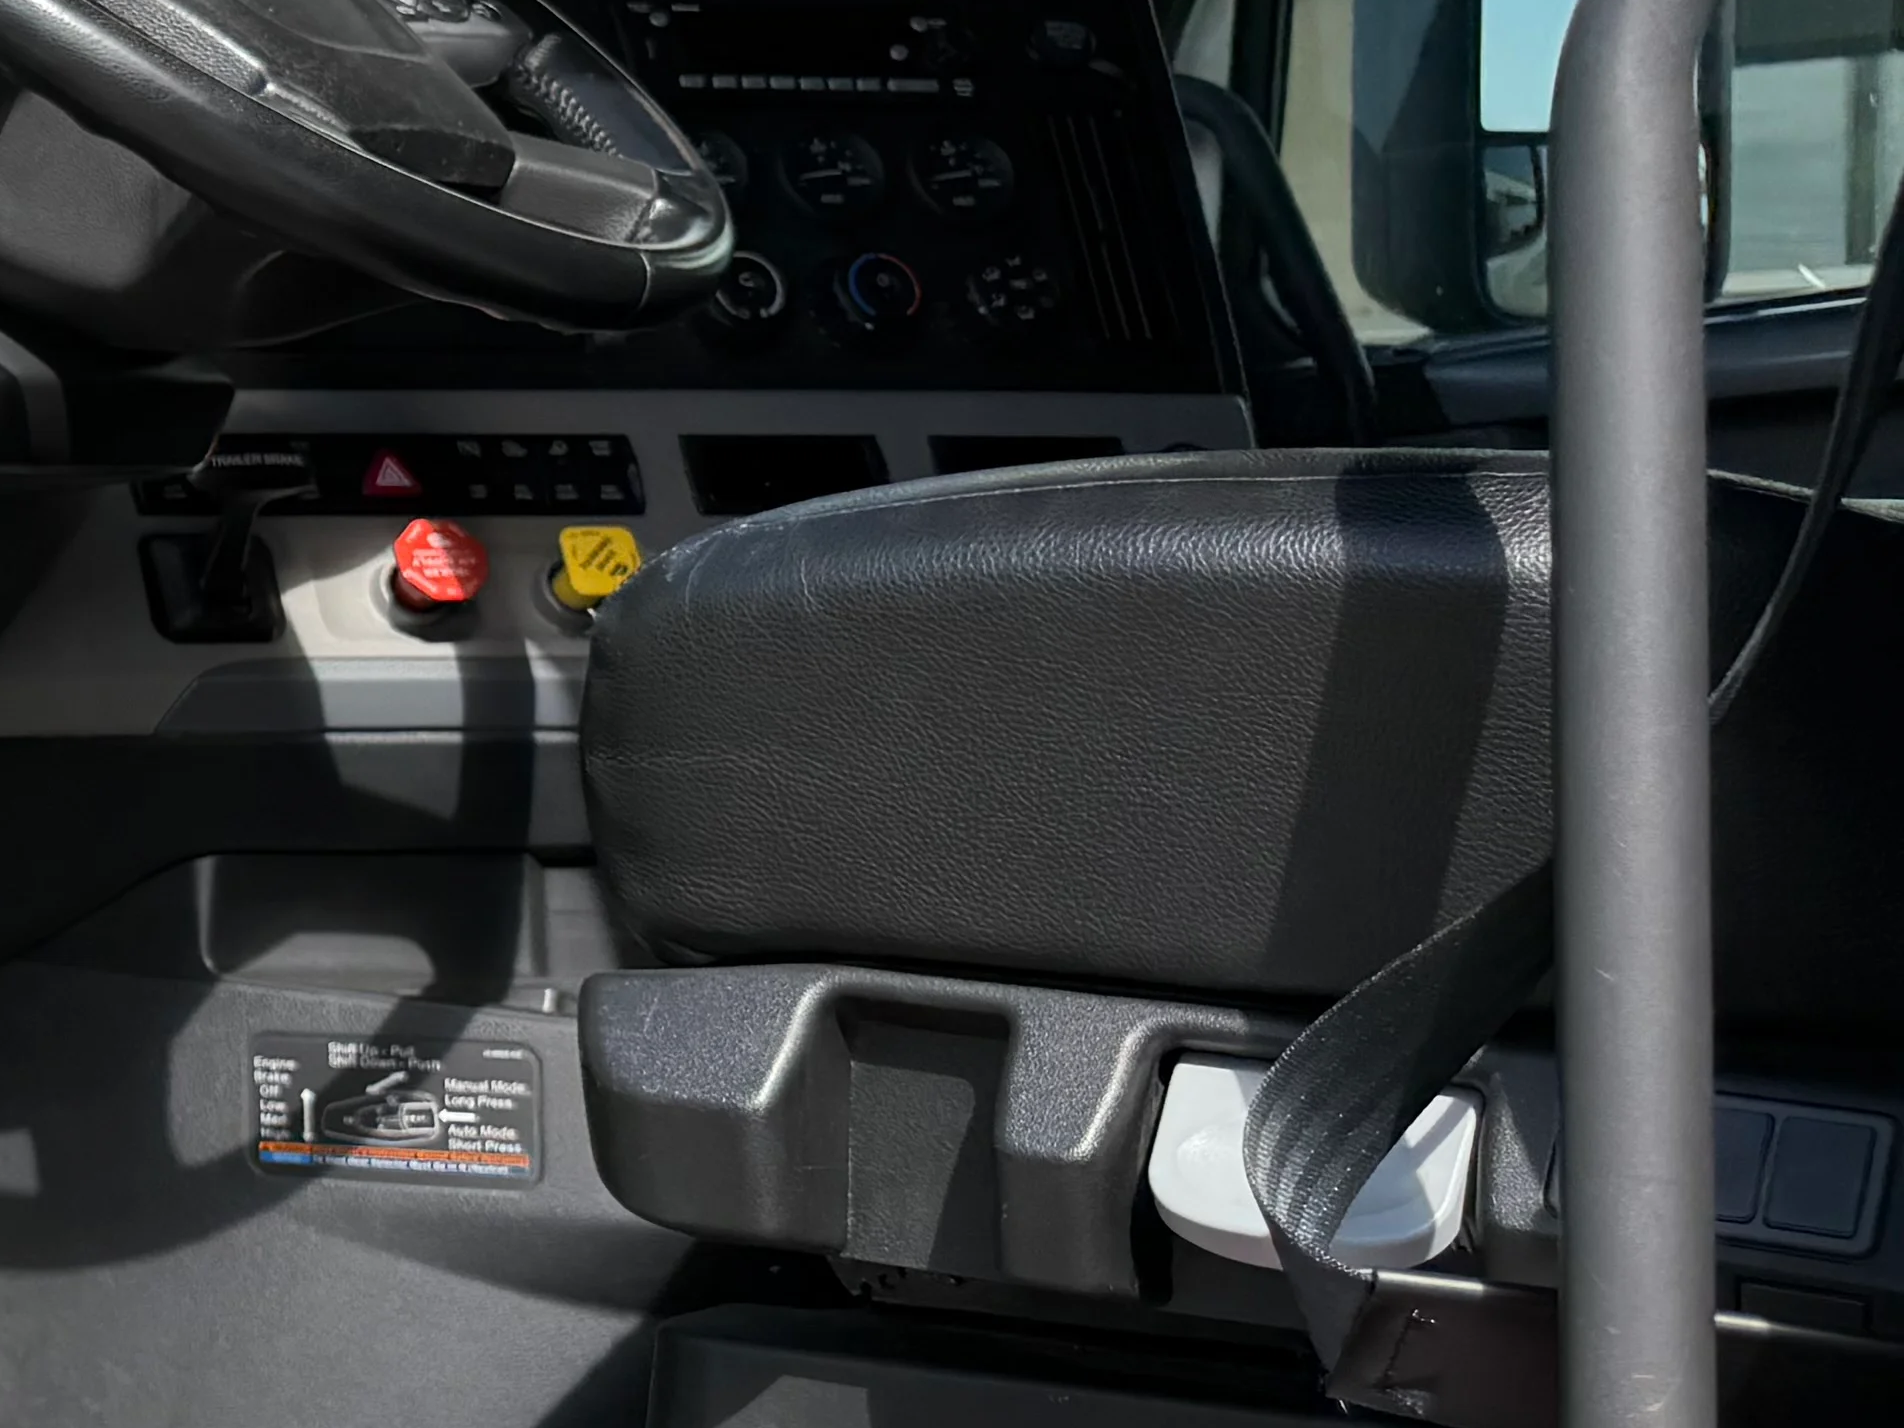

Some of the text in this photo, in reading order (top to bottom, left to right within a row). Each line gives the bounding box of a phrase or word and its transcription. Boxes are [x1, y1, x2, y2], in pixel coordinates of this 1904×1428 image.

[444, 1078, 488, 1091] Manual
[444, 1094, 513, 1108] Long Press
[448, 1138, 522, 1153] Short Press
